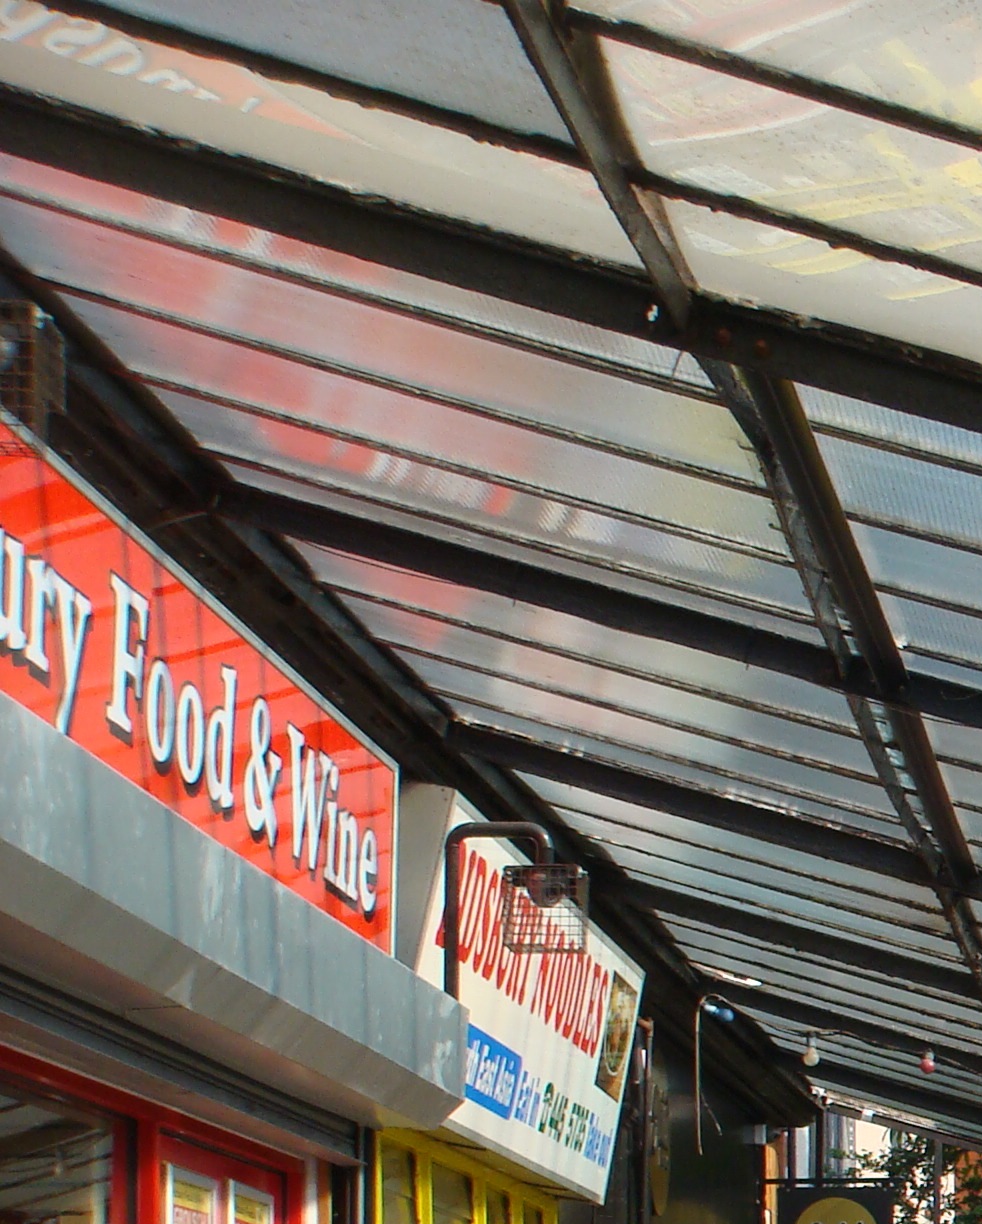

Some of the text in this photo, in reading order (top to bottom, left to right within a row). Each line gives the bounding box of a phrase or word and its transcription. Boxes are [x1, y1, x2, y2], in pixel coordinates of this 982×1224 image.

[105, 570, 239, 812] Food
[244, 696, 283, 849] &
[286, 721, 380, 912] Wine
[530, 916, 609, 1058] NOODLES
